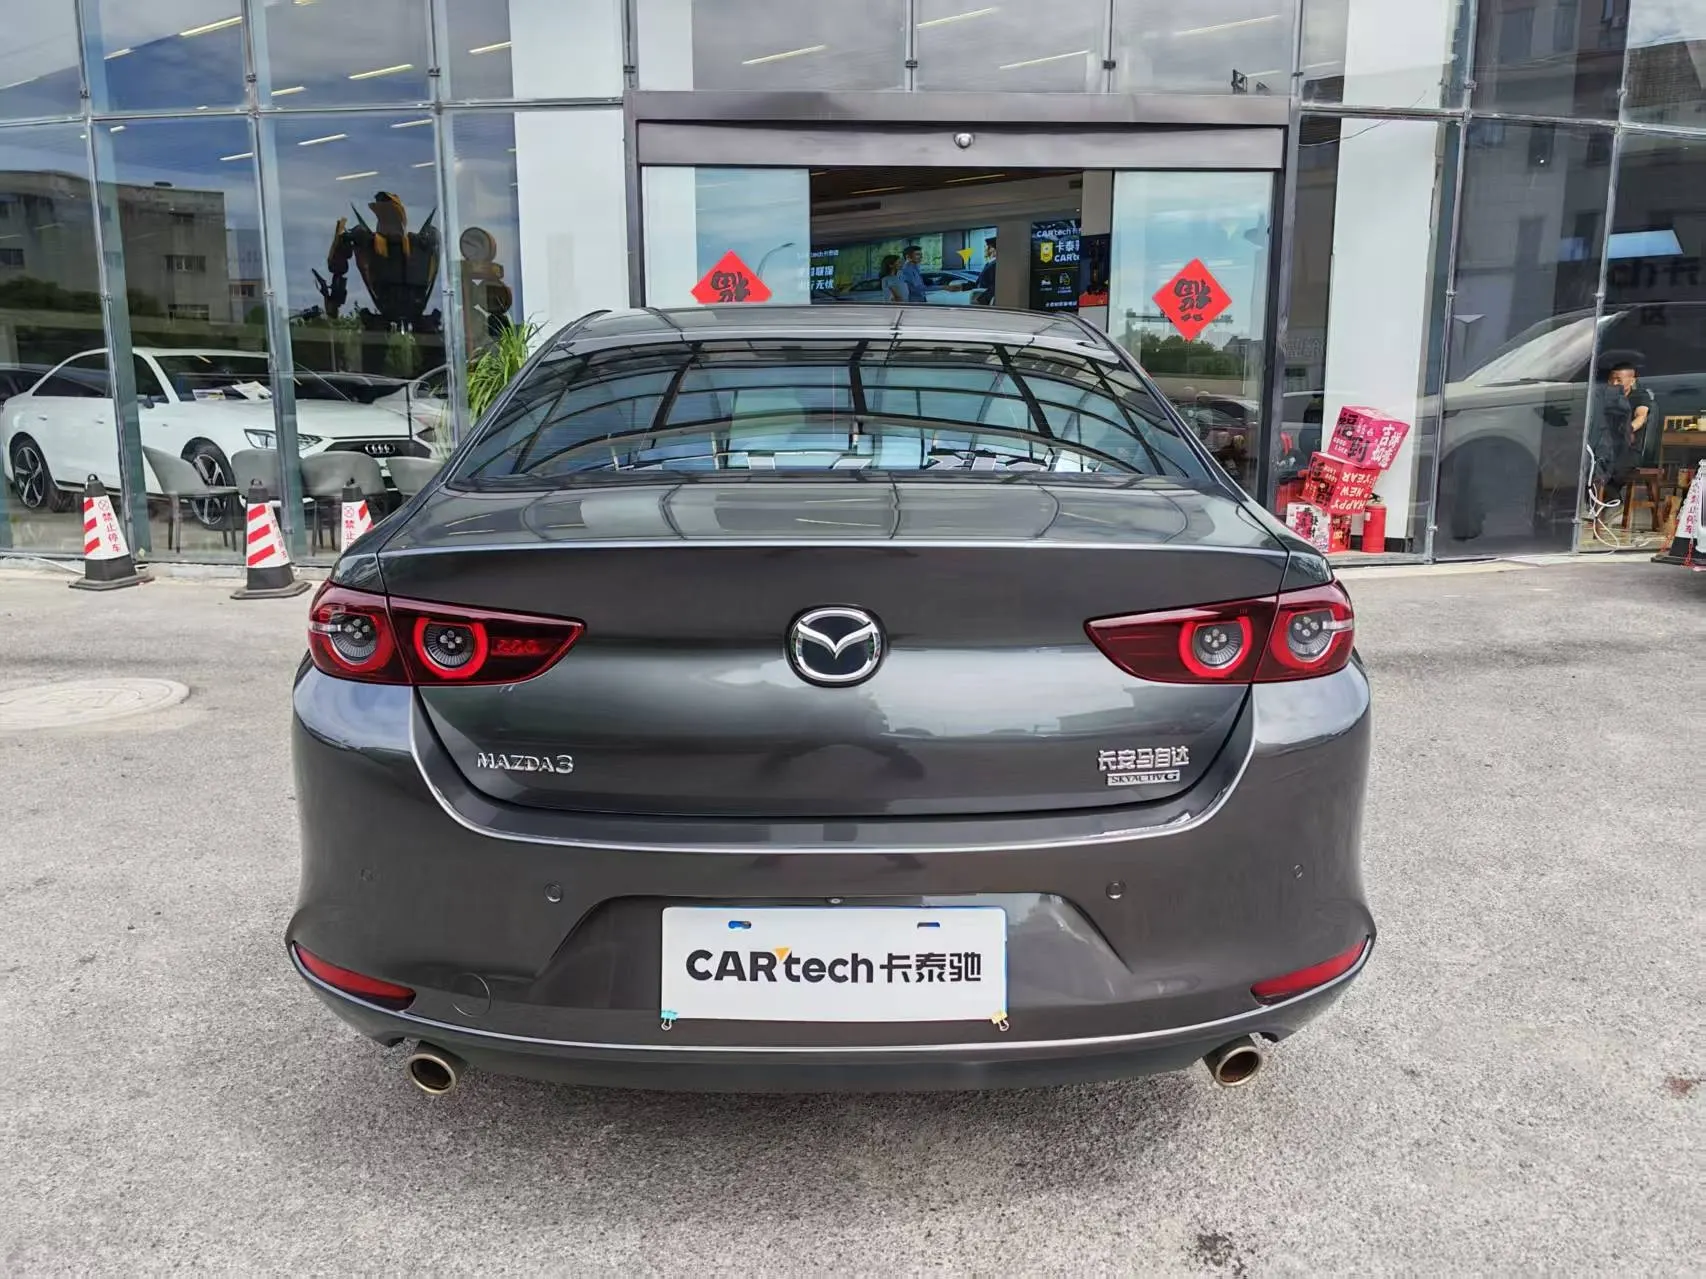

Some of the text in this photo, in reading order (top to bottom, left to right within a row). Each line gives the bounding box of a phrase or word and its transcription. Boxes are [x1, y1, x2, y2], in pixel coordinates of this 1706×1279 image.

[1174, 278, 1212, 322] 福
[1341, 472, 1371, 485] YEAR
[1340, 486, 1363, 498] NEW
[1331, 498, 1366, 510] HAPPY
[102, 512, 121, 552] 禁止停车
[477, 752, 574, 774] MAZDA3
[1098, 745, 1190, 771] 长安马自达
